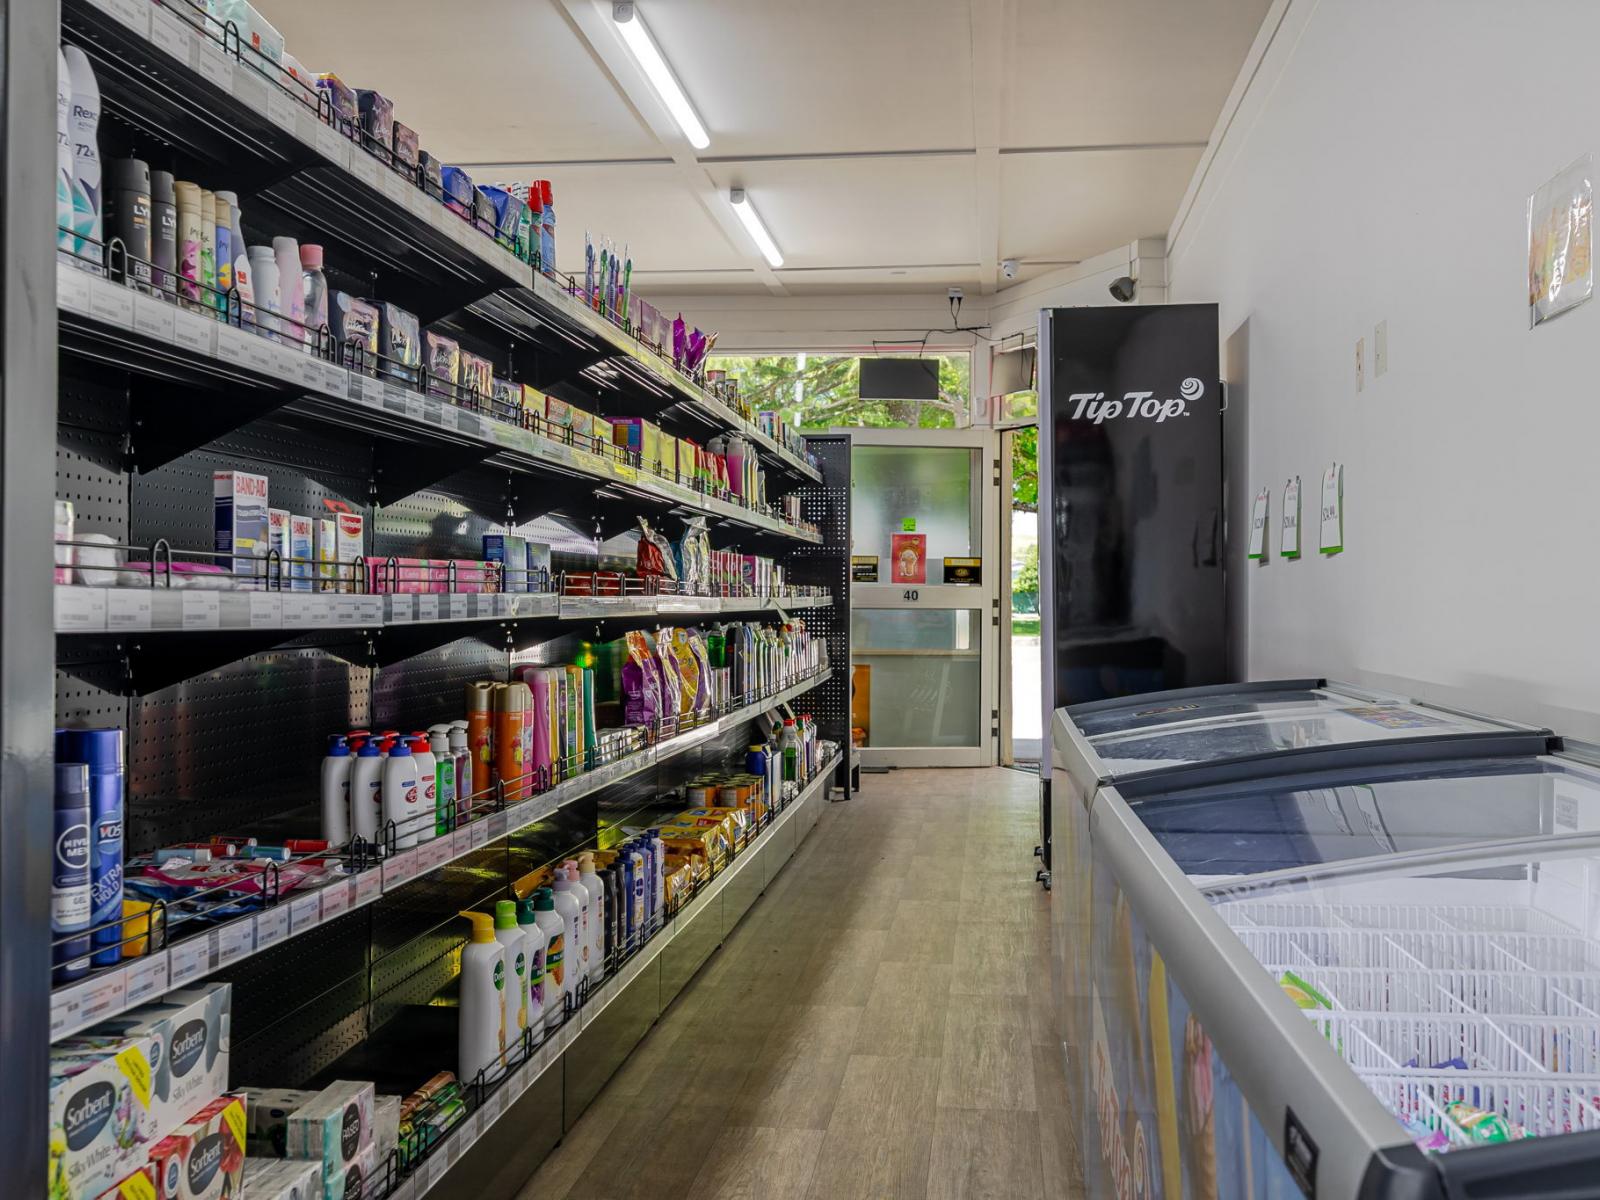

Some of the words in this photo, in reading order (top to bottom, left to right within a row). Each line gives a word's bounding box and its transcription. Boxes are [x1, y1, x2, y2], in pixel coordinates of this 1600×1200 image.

[1068, 391, 1123, 424] Tip
[1123, 391, 1186, 423] Top
[235, 475, 267, 498] BAND-AID
[903, 590, 919, 601] 40
[91, 863, 122, 897] EXTRA
[95, 881, 120, 906] HOLD
[172, 1025, 206, 1059] Sorbent
[66, 1085, 111, 1131] Sorbent
[190, 1139, 222, 1178] Sorbent
